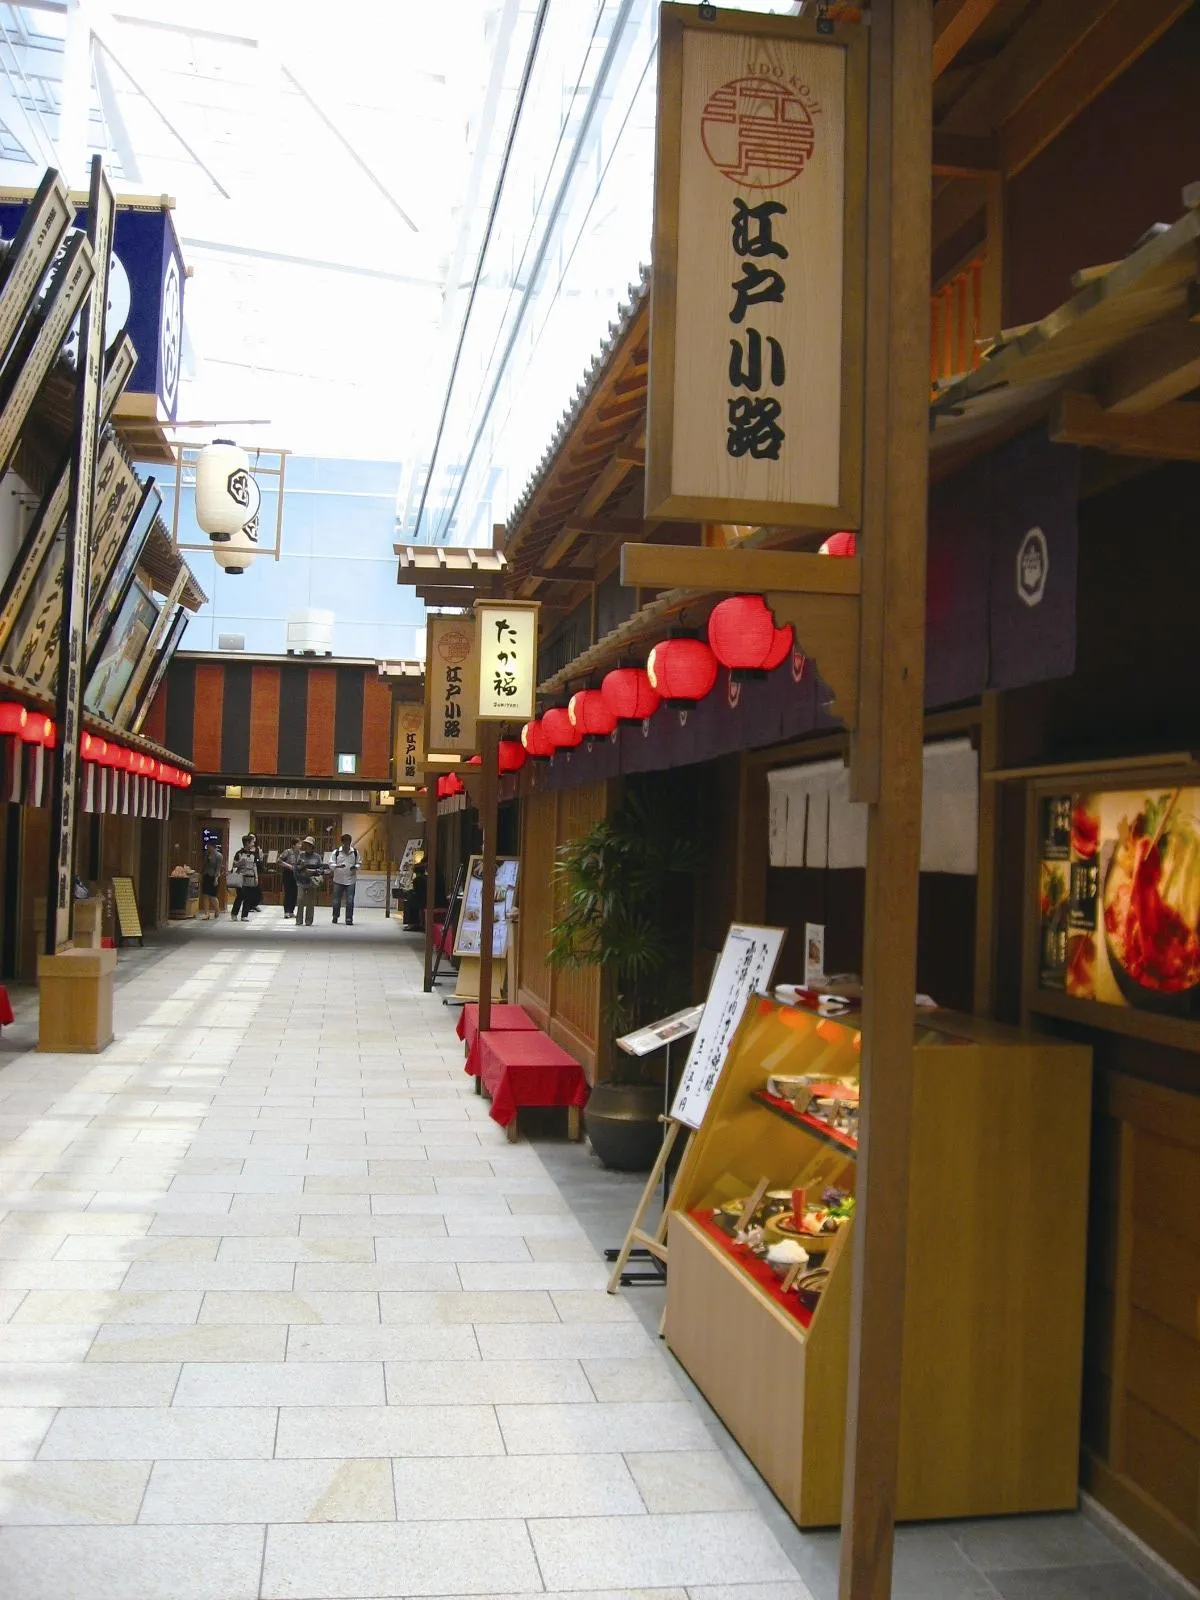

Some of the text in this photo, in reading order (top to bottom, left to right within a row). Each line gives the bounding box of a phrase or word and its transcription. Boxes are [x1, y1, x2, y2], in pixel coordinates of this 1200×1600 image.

[725, 197, 789, 461] 江戸小路
[493, 618, 518, 697] たか福
[444, 665, 462, 738] 江戸小路
[405, 732, 417, 777] 江戸小路
